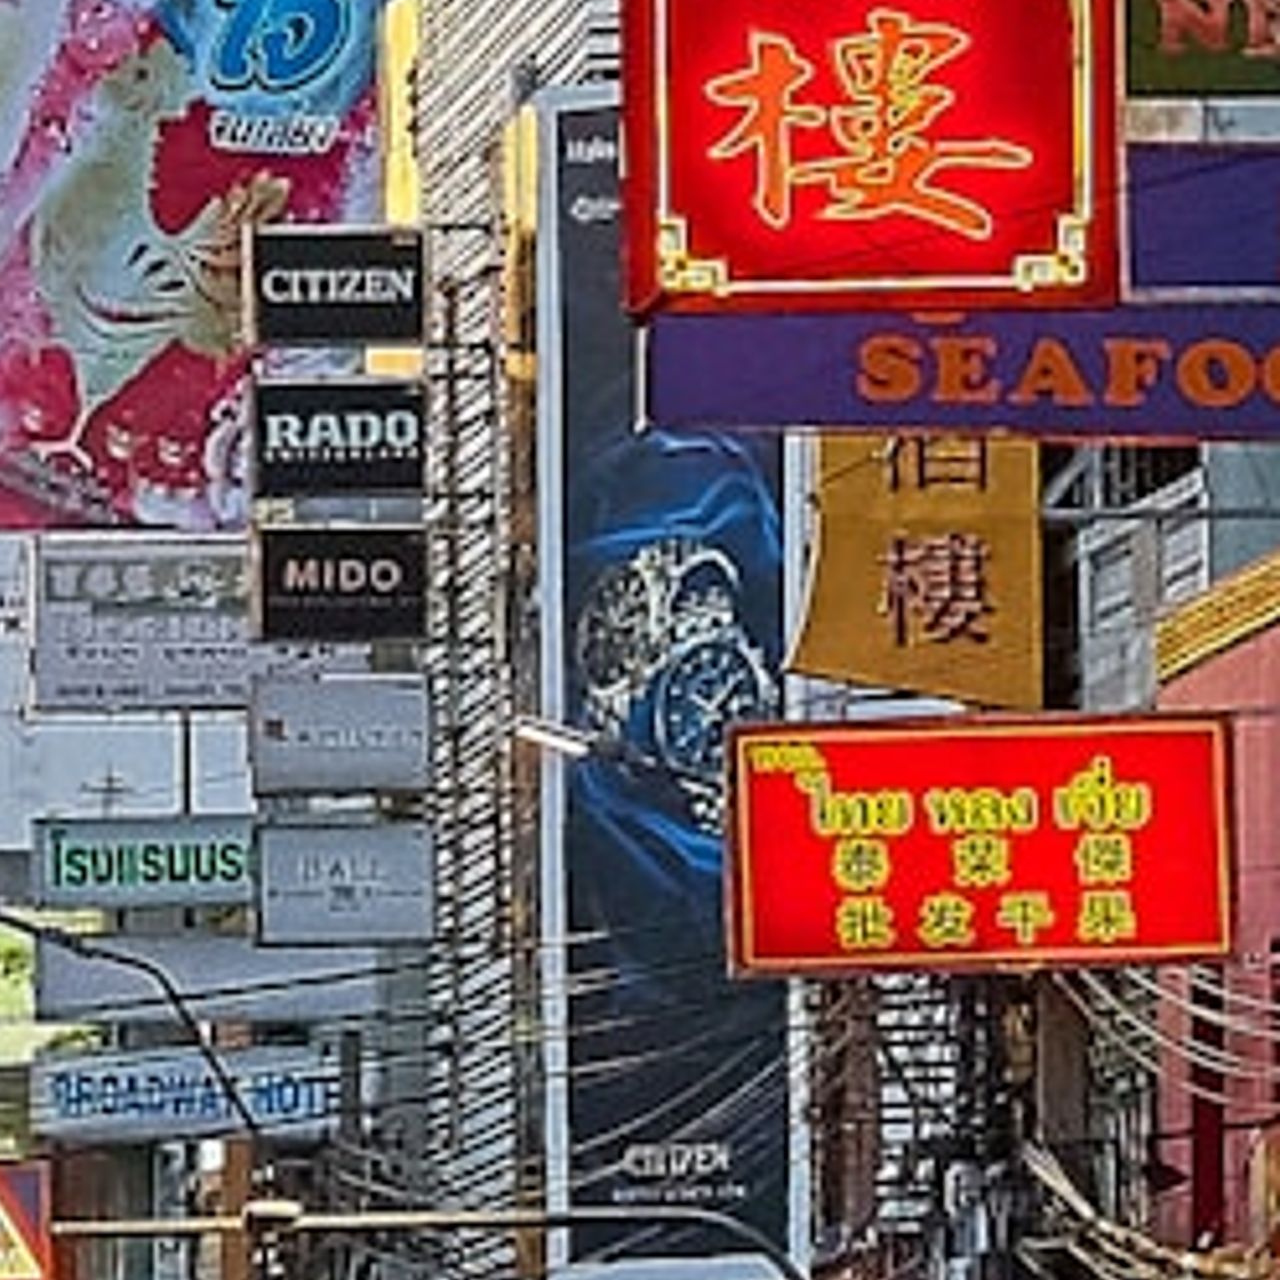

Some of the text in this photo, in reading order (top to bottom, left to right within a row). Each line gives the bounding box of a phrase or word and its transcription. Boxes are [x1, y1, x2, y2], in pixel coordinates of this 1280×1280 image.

[261, 270, 416, 304] CITIZEN
[855, 336, 1280, 408] SEAFO
[265, 409, 420, 449] RADO
[284, 558, 402, 592] MIDO
